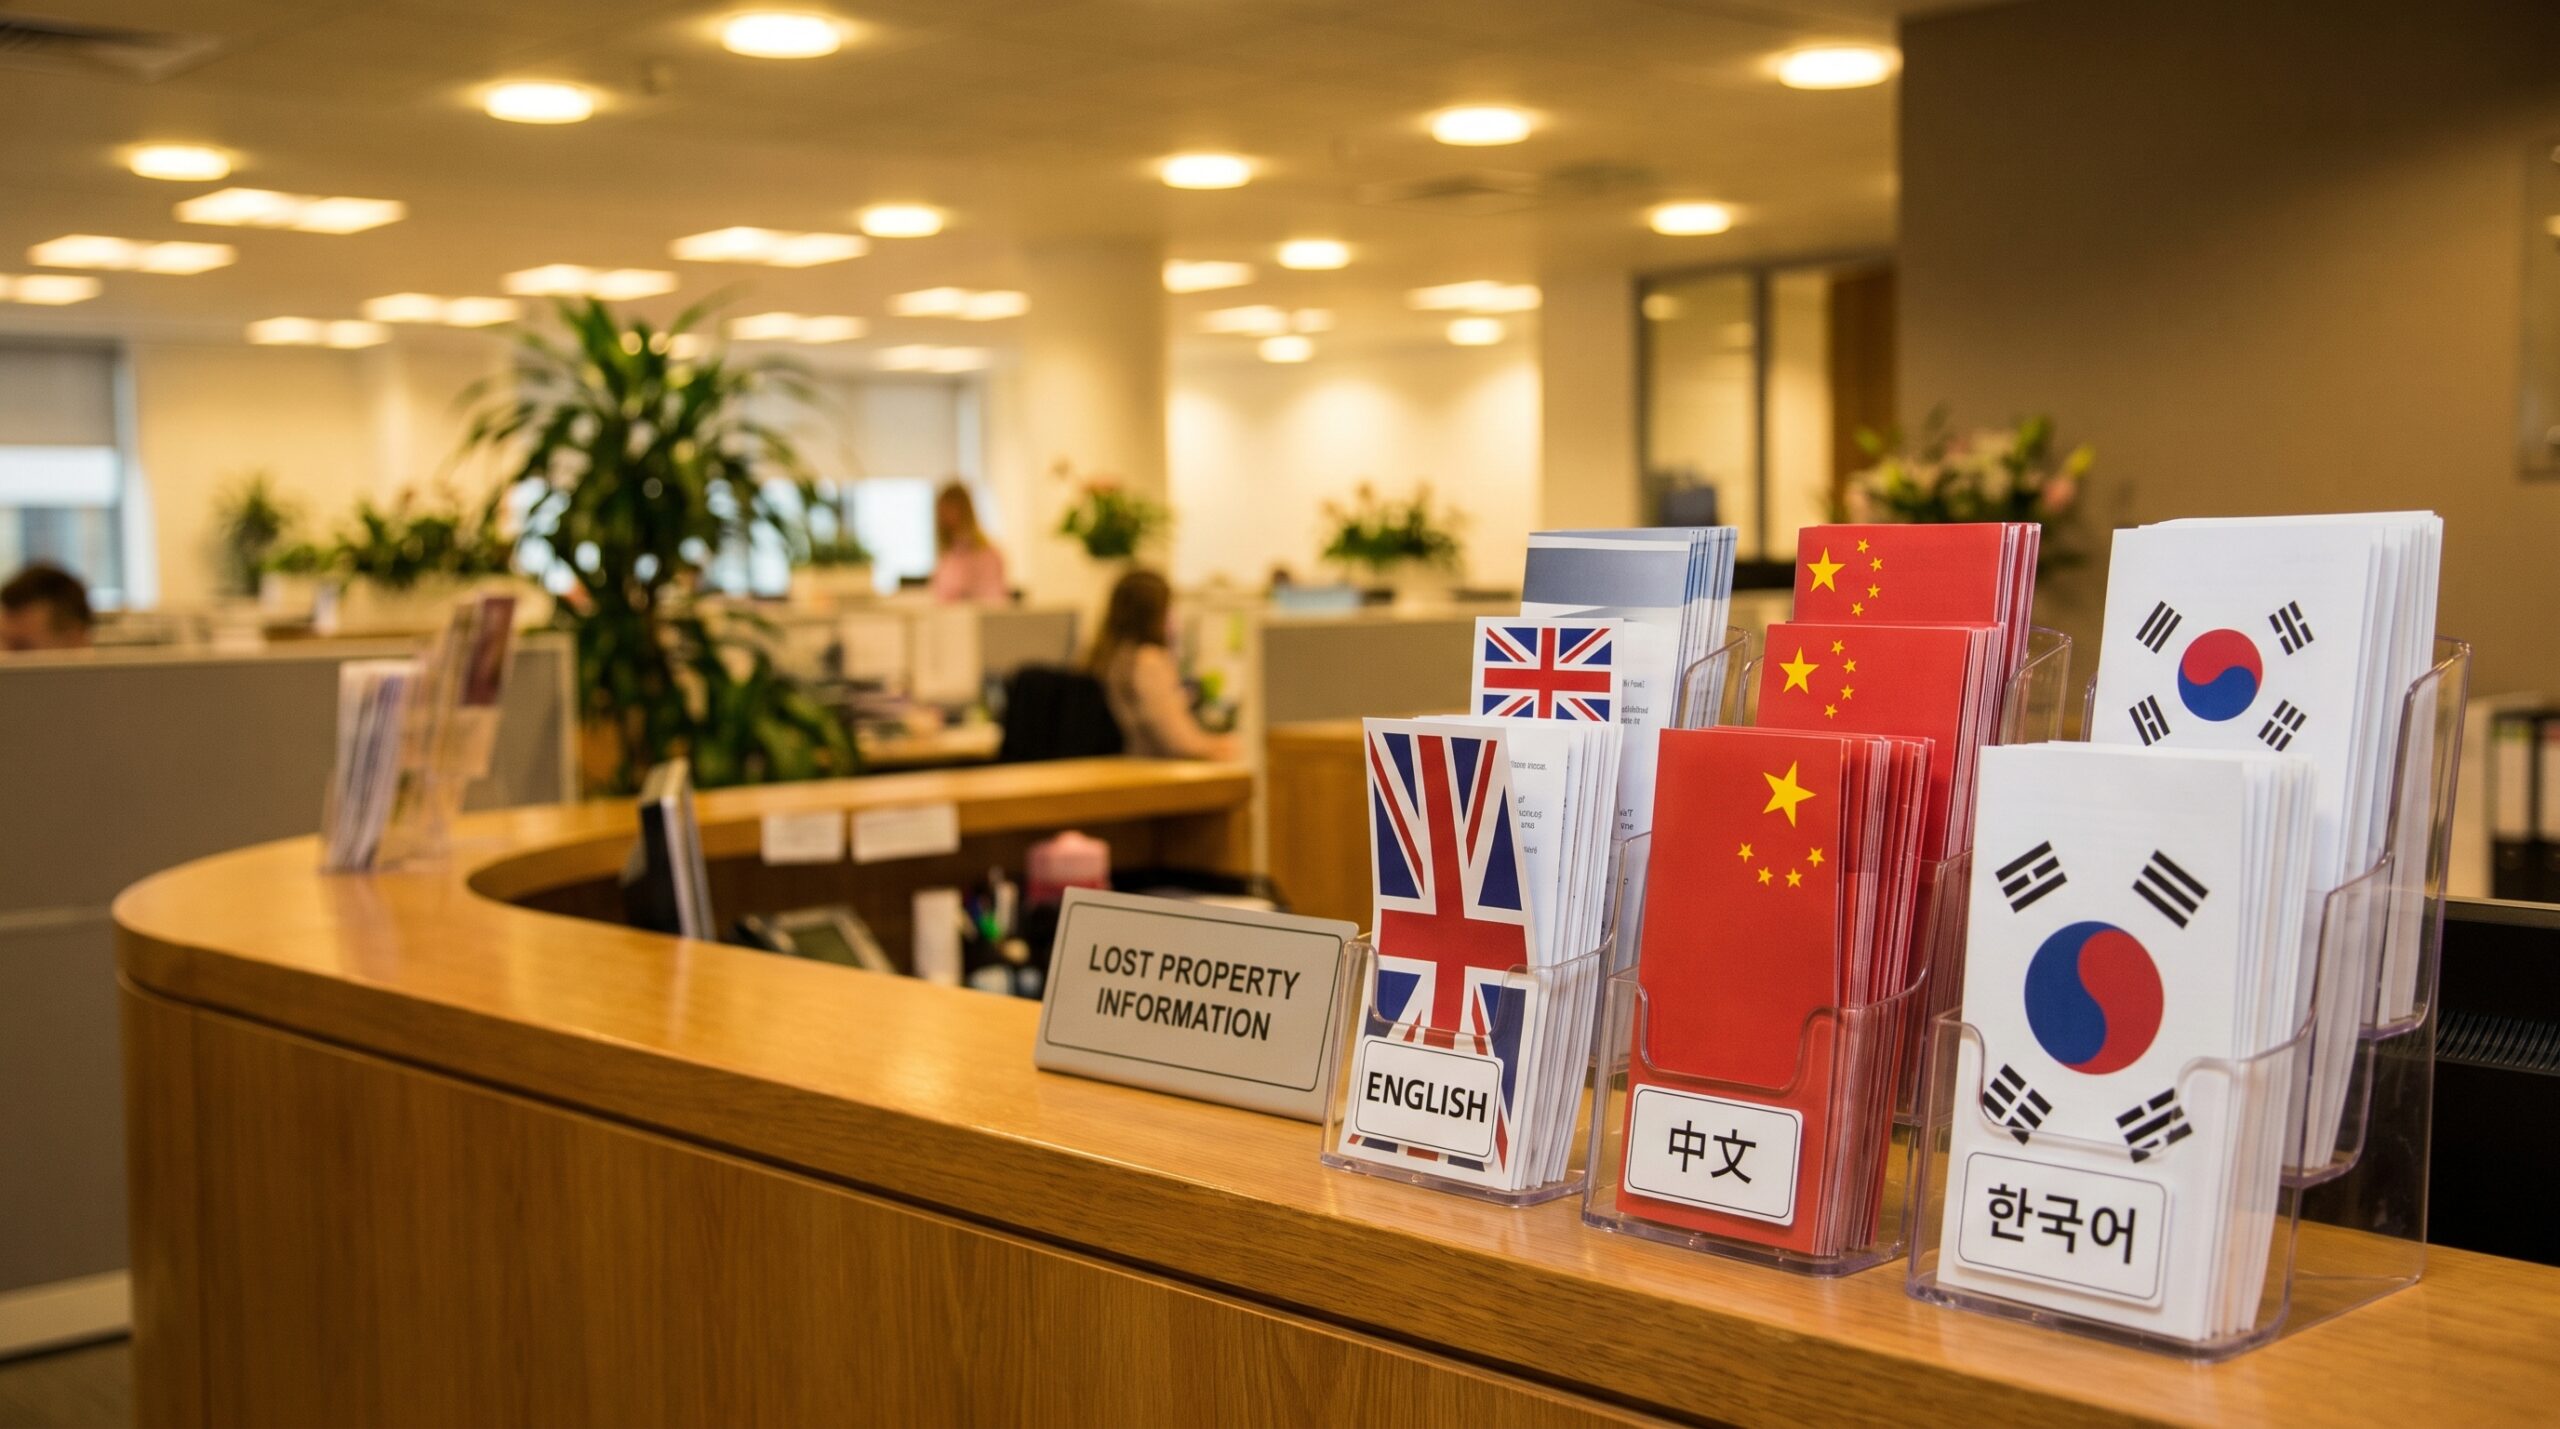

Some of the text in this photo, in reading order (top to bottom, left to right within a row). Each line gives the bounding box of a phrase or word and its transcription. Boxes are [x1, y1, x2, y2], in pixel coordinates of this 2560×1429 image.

[1089, 944, 1300, 1000] LOST PROPERTY
[1096, 987, 1271, 1041] INFORMATION
[1366, 1071, 1488, 1123] ENGLISH
[1668, 1120, 1756, 1184] 中文
[1987, 1183, 2136, 1265] 한국어
